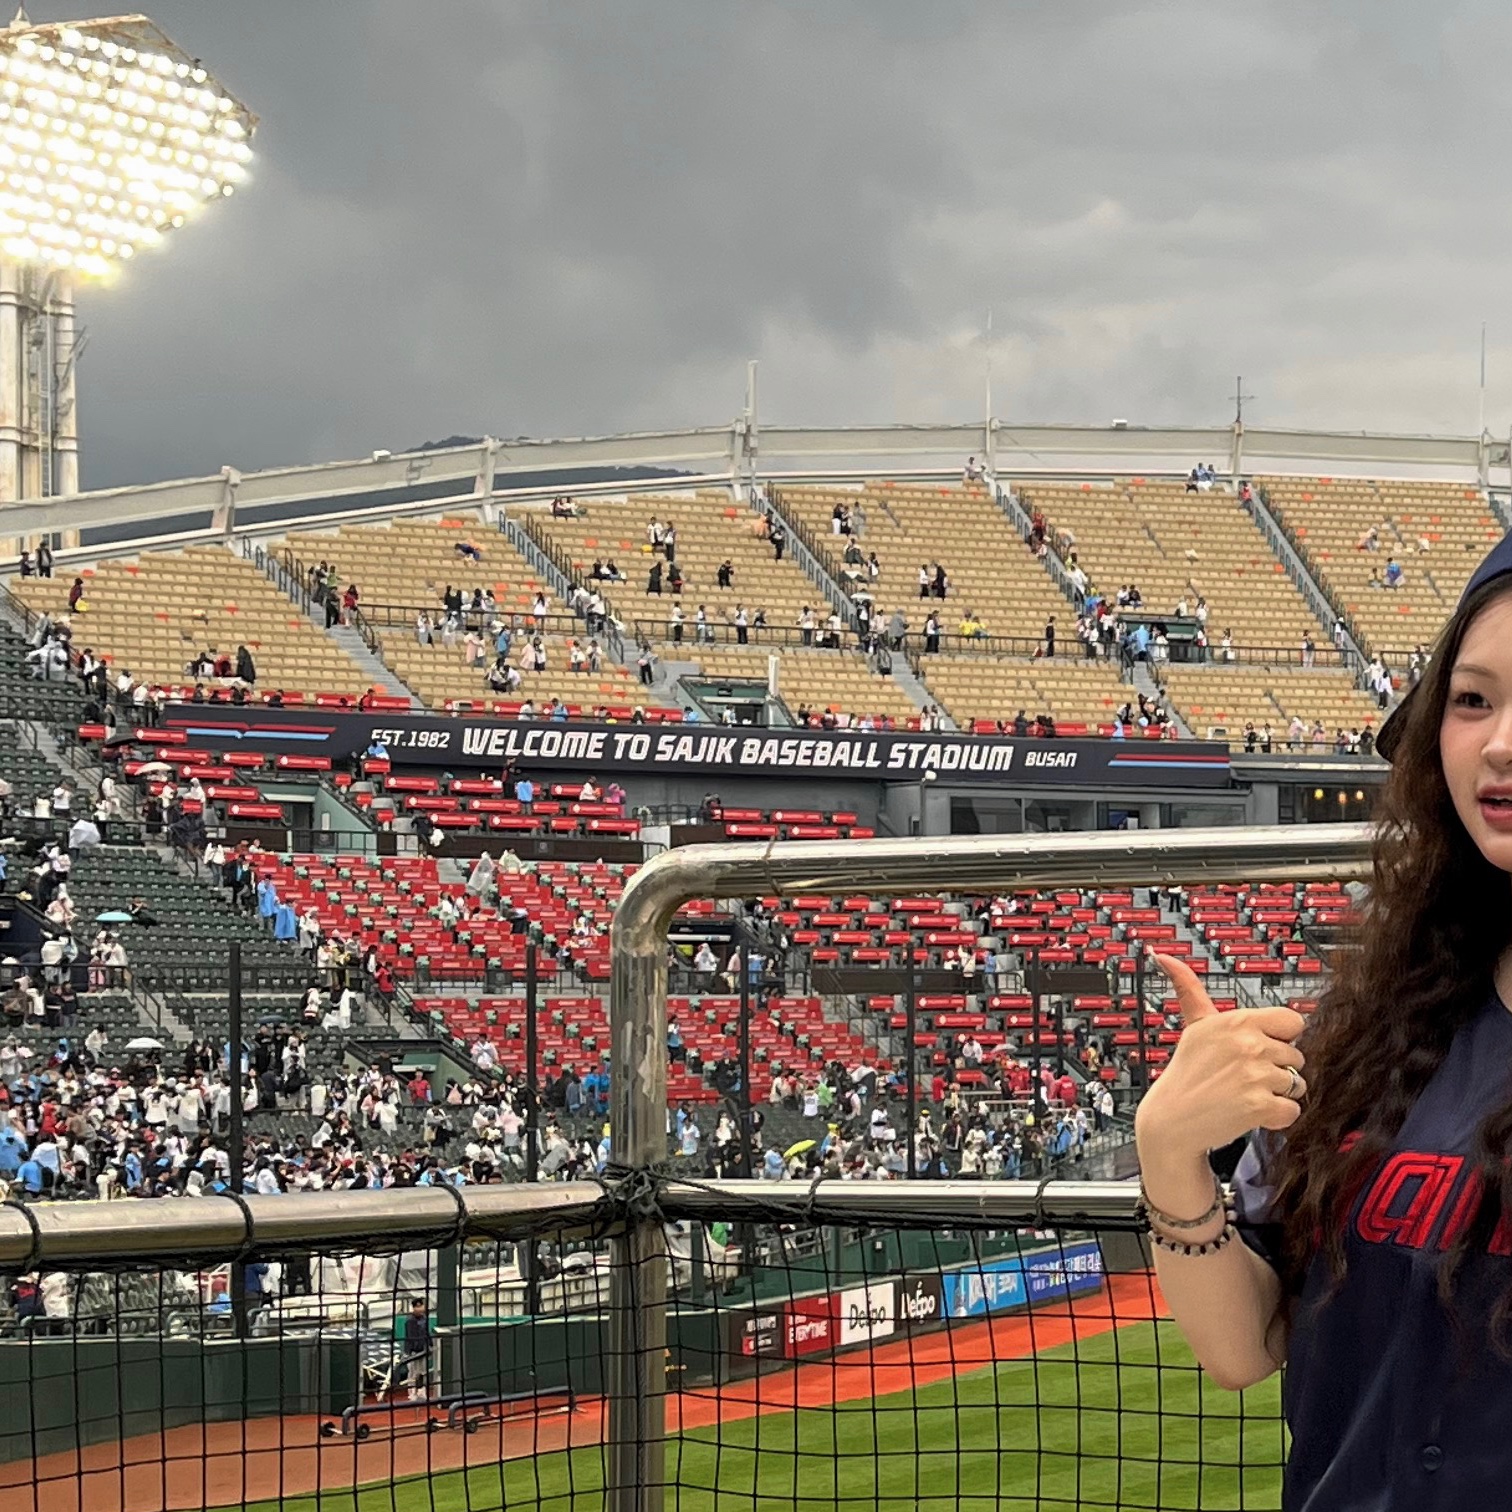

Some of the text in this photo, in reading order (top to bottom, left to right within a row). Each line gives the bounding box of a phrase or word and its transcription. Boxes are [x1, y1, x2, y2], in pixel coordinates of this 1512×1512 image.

[371, 727, 1078, 772] EST.1982 WELCOME TO SAJIK BASEBALL STADIUM BUSAN
